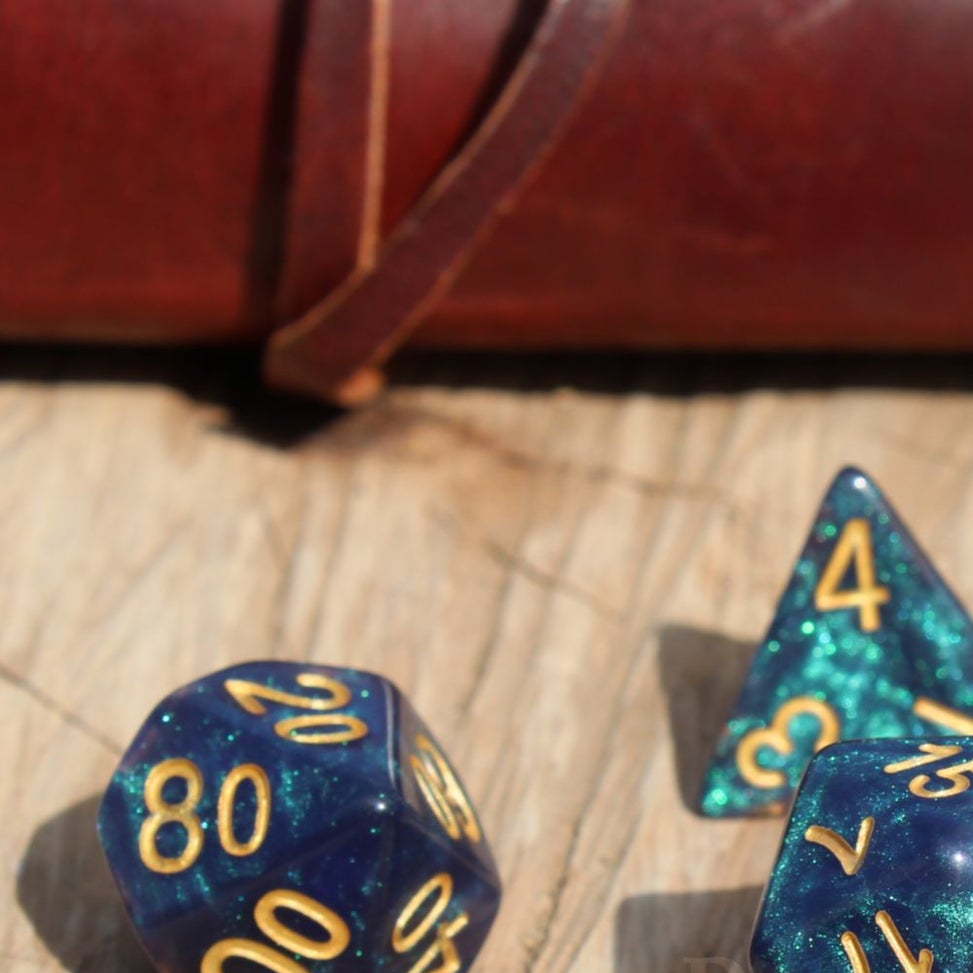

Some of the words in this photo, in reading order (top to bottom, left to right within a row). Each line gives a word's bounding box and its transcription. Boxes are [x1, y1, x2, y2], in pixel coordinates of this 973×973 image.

[815, 517, 890, 632] 4
[224, 673, 369, 744] 20
[736, 695, 841, 789] 3
[138, 757, 271, 874] 80
[805, 816, 875, 876] 7
